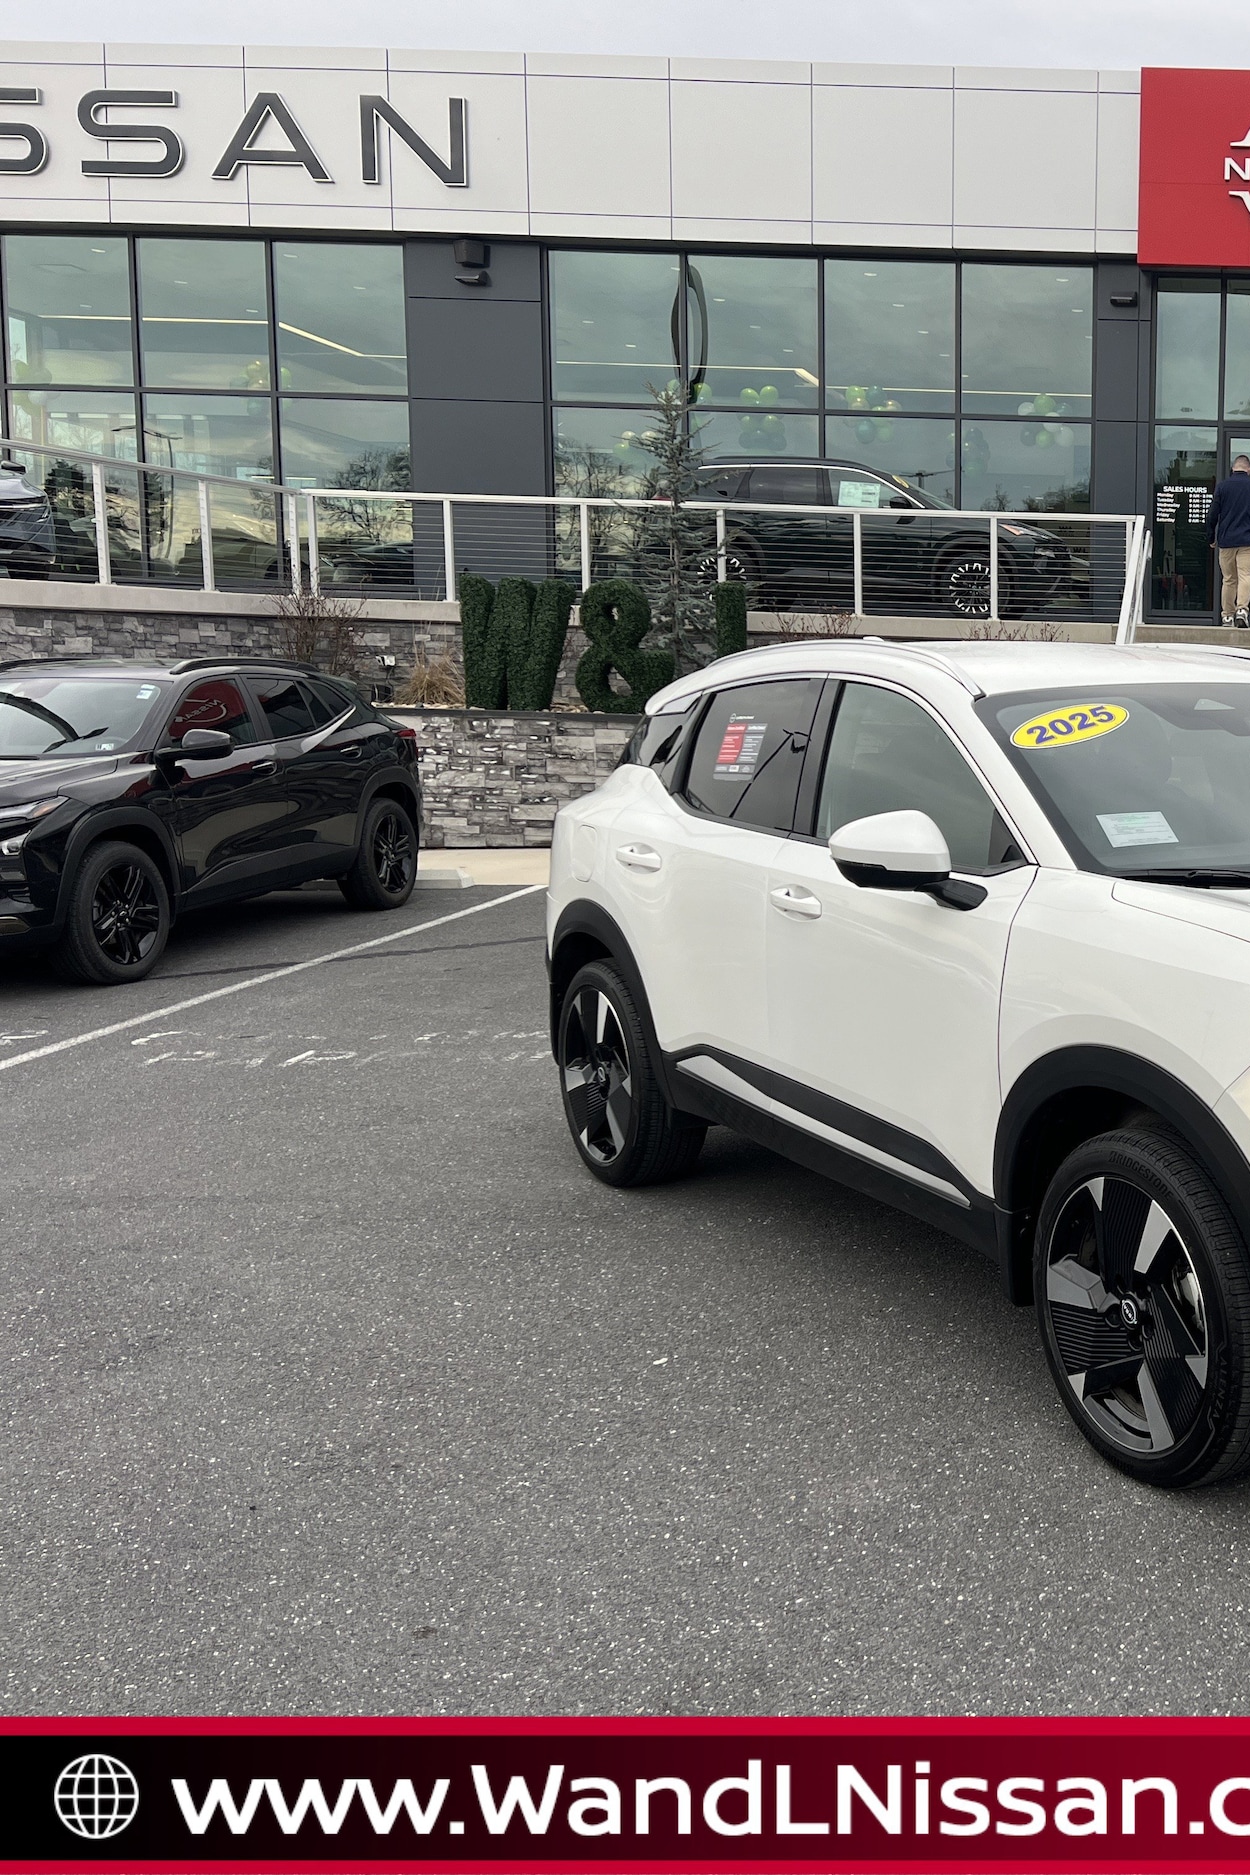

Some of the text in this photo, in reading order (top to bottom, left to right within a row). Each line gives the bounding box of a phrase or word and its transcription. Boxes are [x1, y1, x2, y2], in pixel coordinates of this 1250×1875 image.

[1027, 705, 1115, 744] 2025
[1108, 1150, 1174, 1201] BRIDGESTONE
[1212, 1356, 1228, 1418] ALENZA
